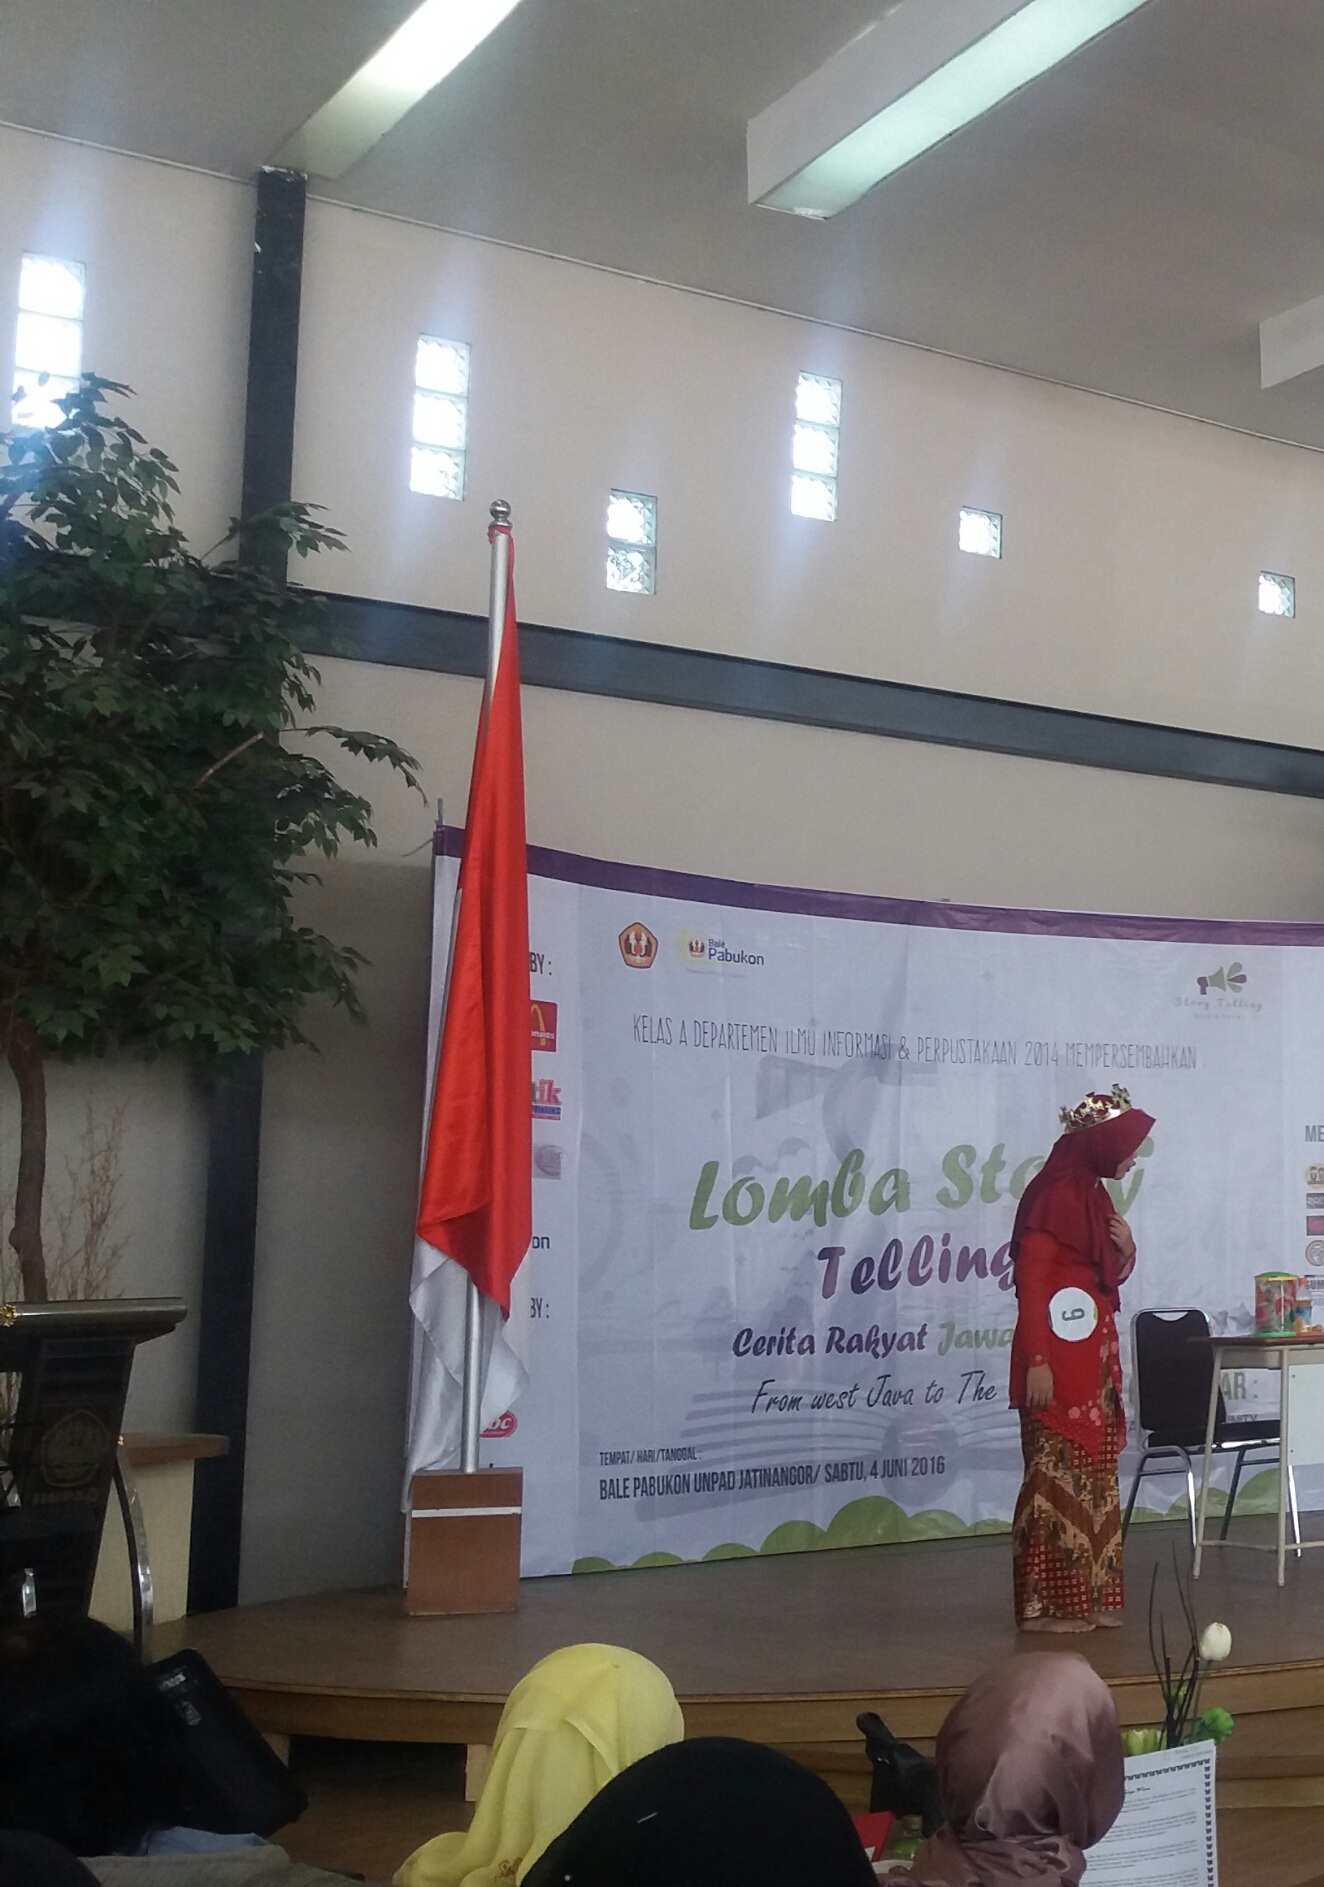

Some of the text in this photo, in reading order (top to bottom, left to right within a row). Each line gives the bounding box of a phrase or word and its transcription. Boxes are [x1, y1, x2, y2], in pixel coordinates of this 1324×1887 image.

[707, 947, 765, 966] Pabukon
[633, 1013, 1197, 1069] KELAS A DEPARTEMEN ILMU INFORMASI & PERPUSTAKAAN 2014 MEMPERSEMBAHKAN
[688, 1143, 1146, 1230] Lomba Stoy
[817, 1232, 1016, 1300] Telling
[732, 1325, 816, 1358] Cerita
[825, 1323, 928, 1359] Rakyat
[751, 1370, 998, 1413] From west Java to The
[599, 1450, 636, 1467] TEMPAT/
[599, 1455, 946, 1501] BALE PABUKON UNPAD JATINANGOR/ SABTU, 4 JUNI 2016
